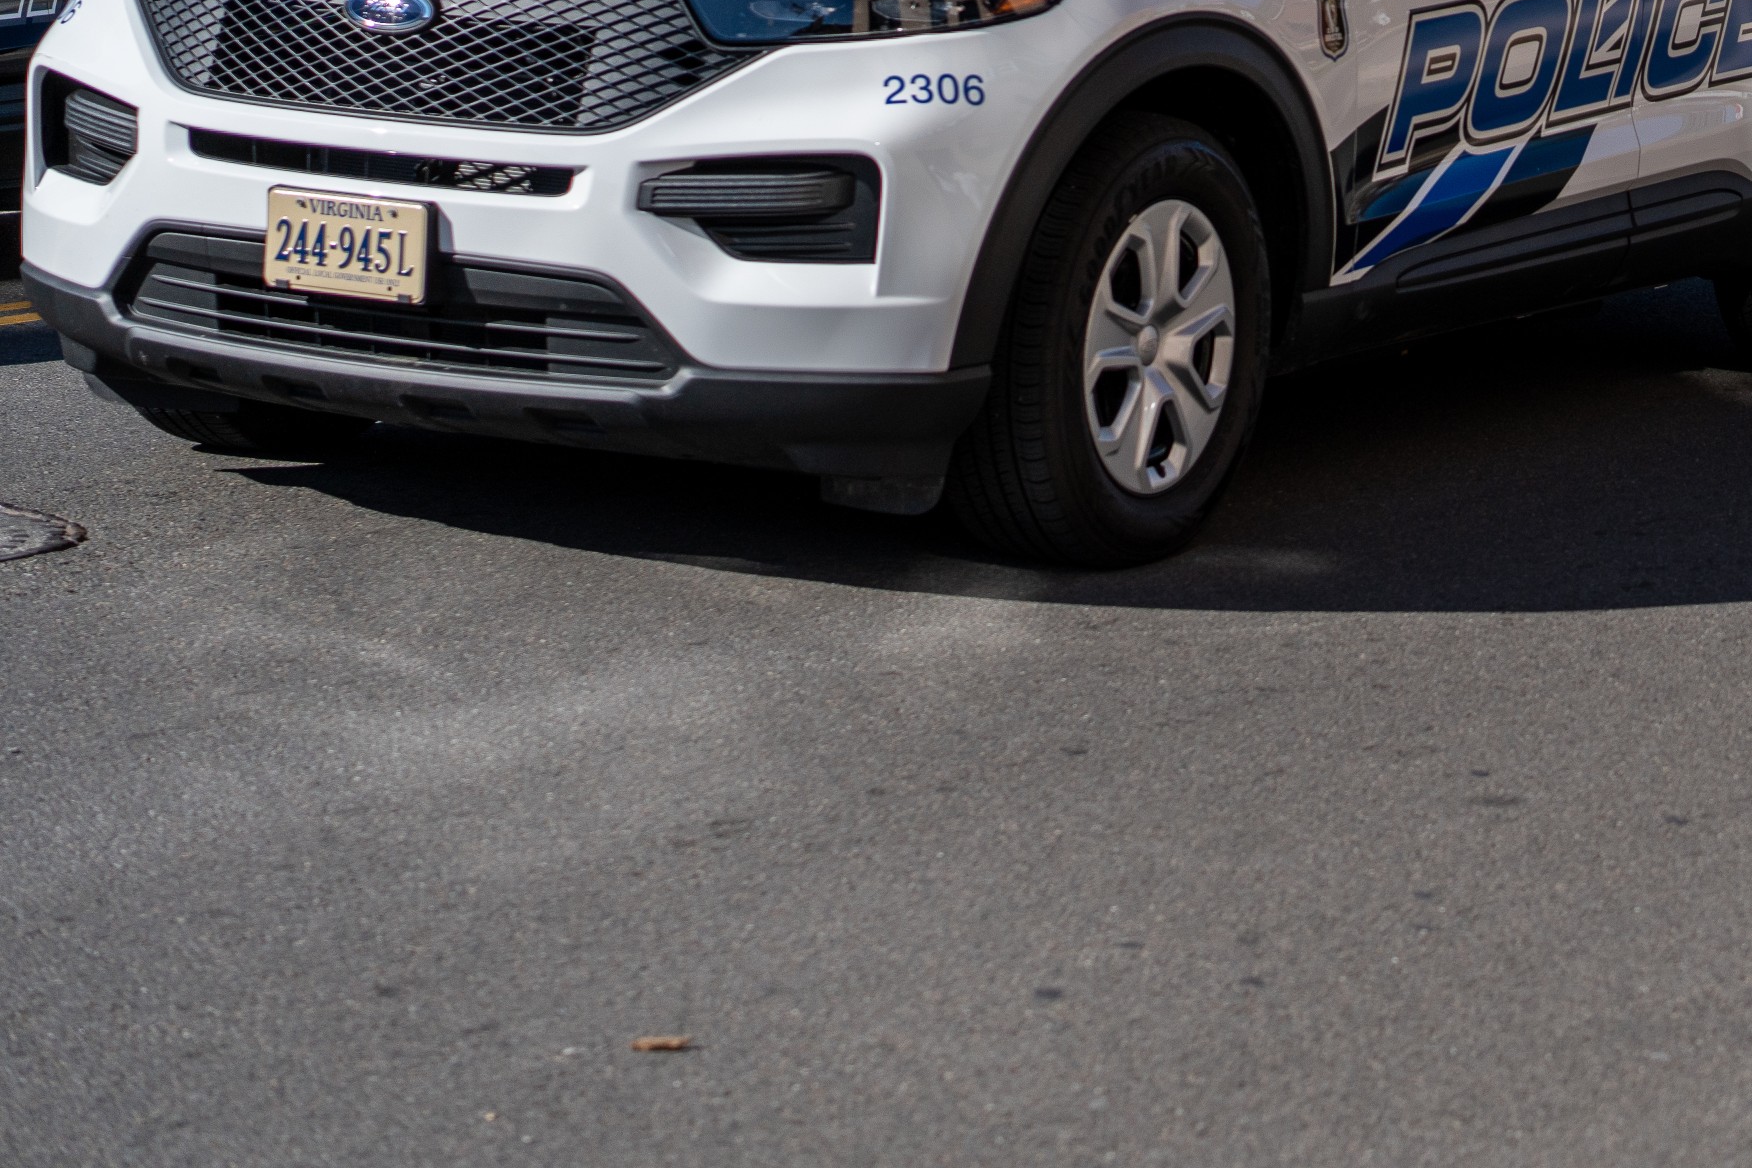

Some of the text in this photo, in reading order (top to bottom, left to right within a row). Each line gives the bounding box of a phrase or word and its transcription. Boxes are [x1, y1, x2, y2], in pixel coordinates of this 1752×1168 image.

[882, 73, 986, 106] 2306
[309, 198, 384, 222] VIRGINIA
[275, 217, 414, 276] 244-945L
